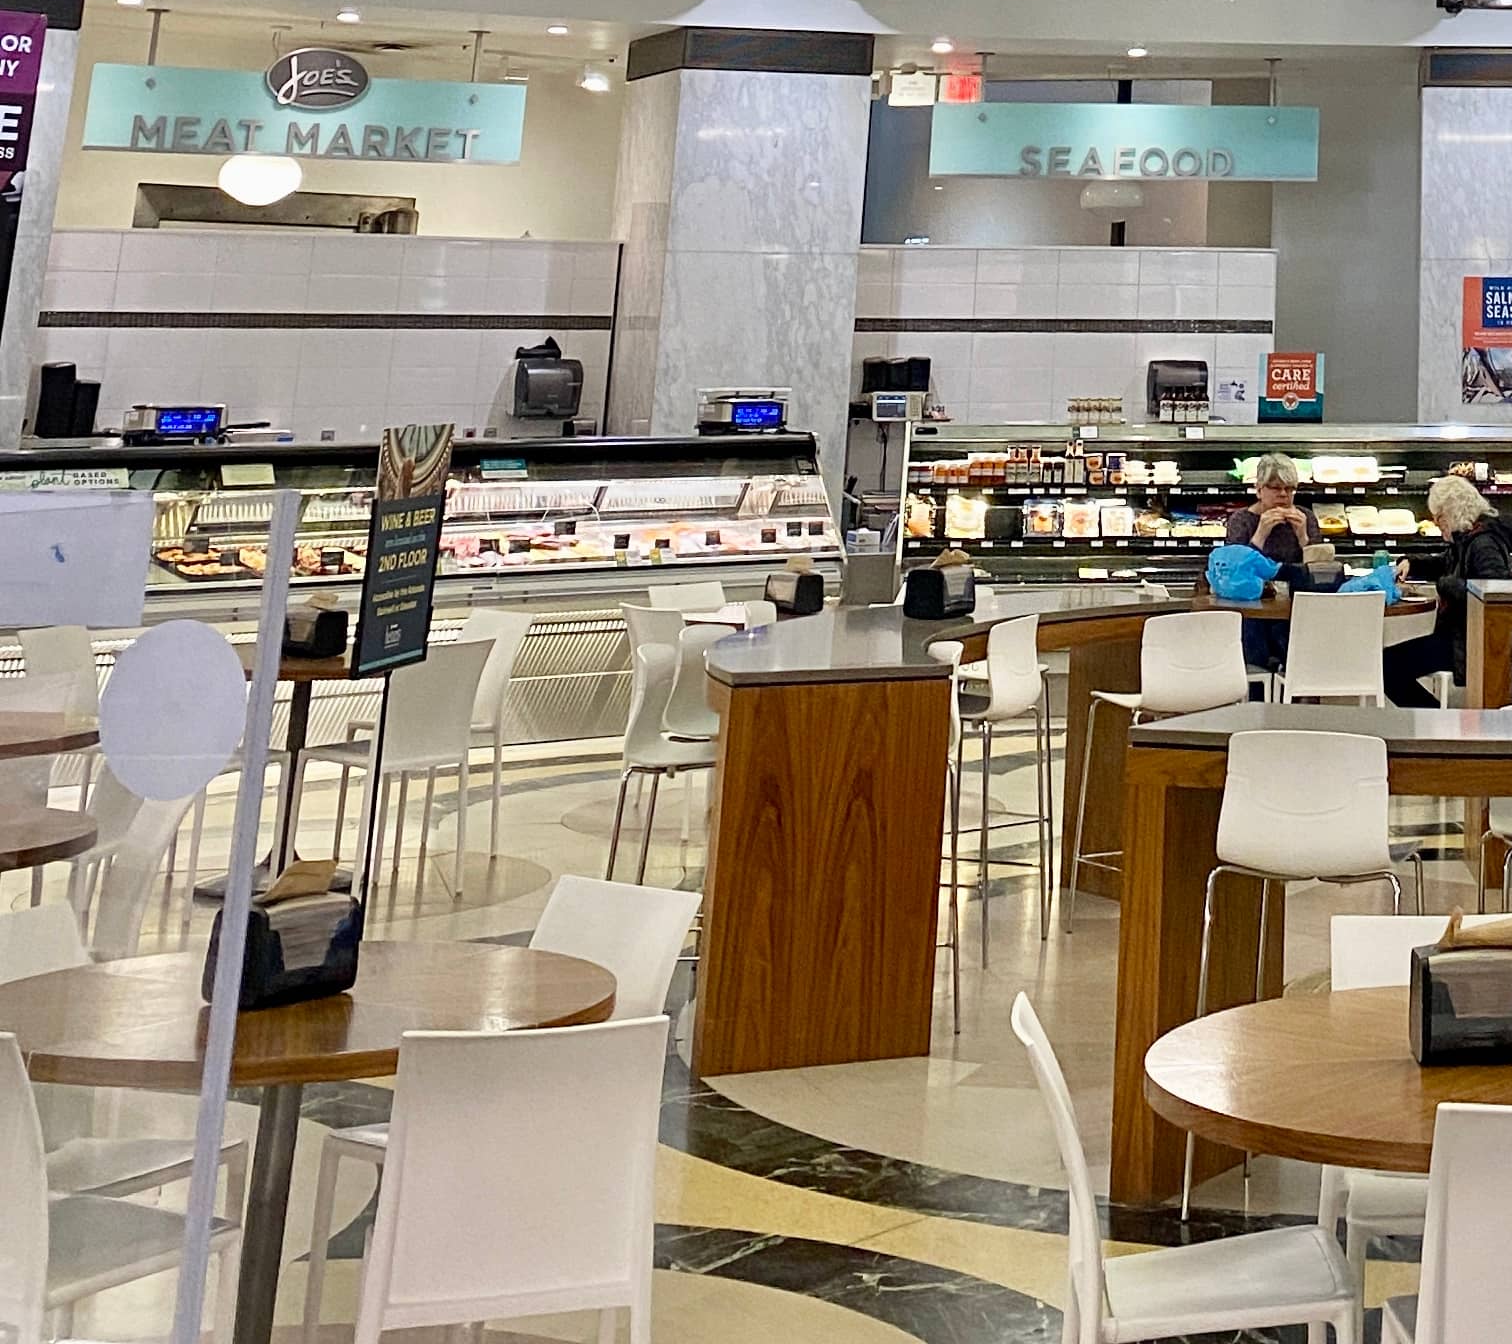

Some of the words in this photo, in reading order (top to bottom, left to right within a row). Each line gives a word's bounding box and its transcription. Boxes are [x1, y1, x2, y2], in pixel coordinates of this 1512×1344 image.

[130, 114, 265, 153] MEAT
[286, 121, 481, 161] MARKET
[1018, 145, 1234, 178] SEAFOOD
[1271, 368, 1312, 381] CARE
[1272, 381, 1310, 391] certified
[73, 478, 120, 486] OPTIONS
[380, 512, 405, 531] WINE
[413, 507, 436, 527] BEER
[378, 553, 398, 573] 2ND
[398, 547, 428, 569] FLOOR
